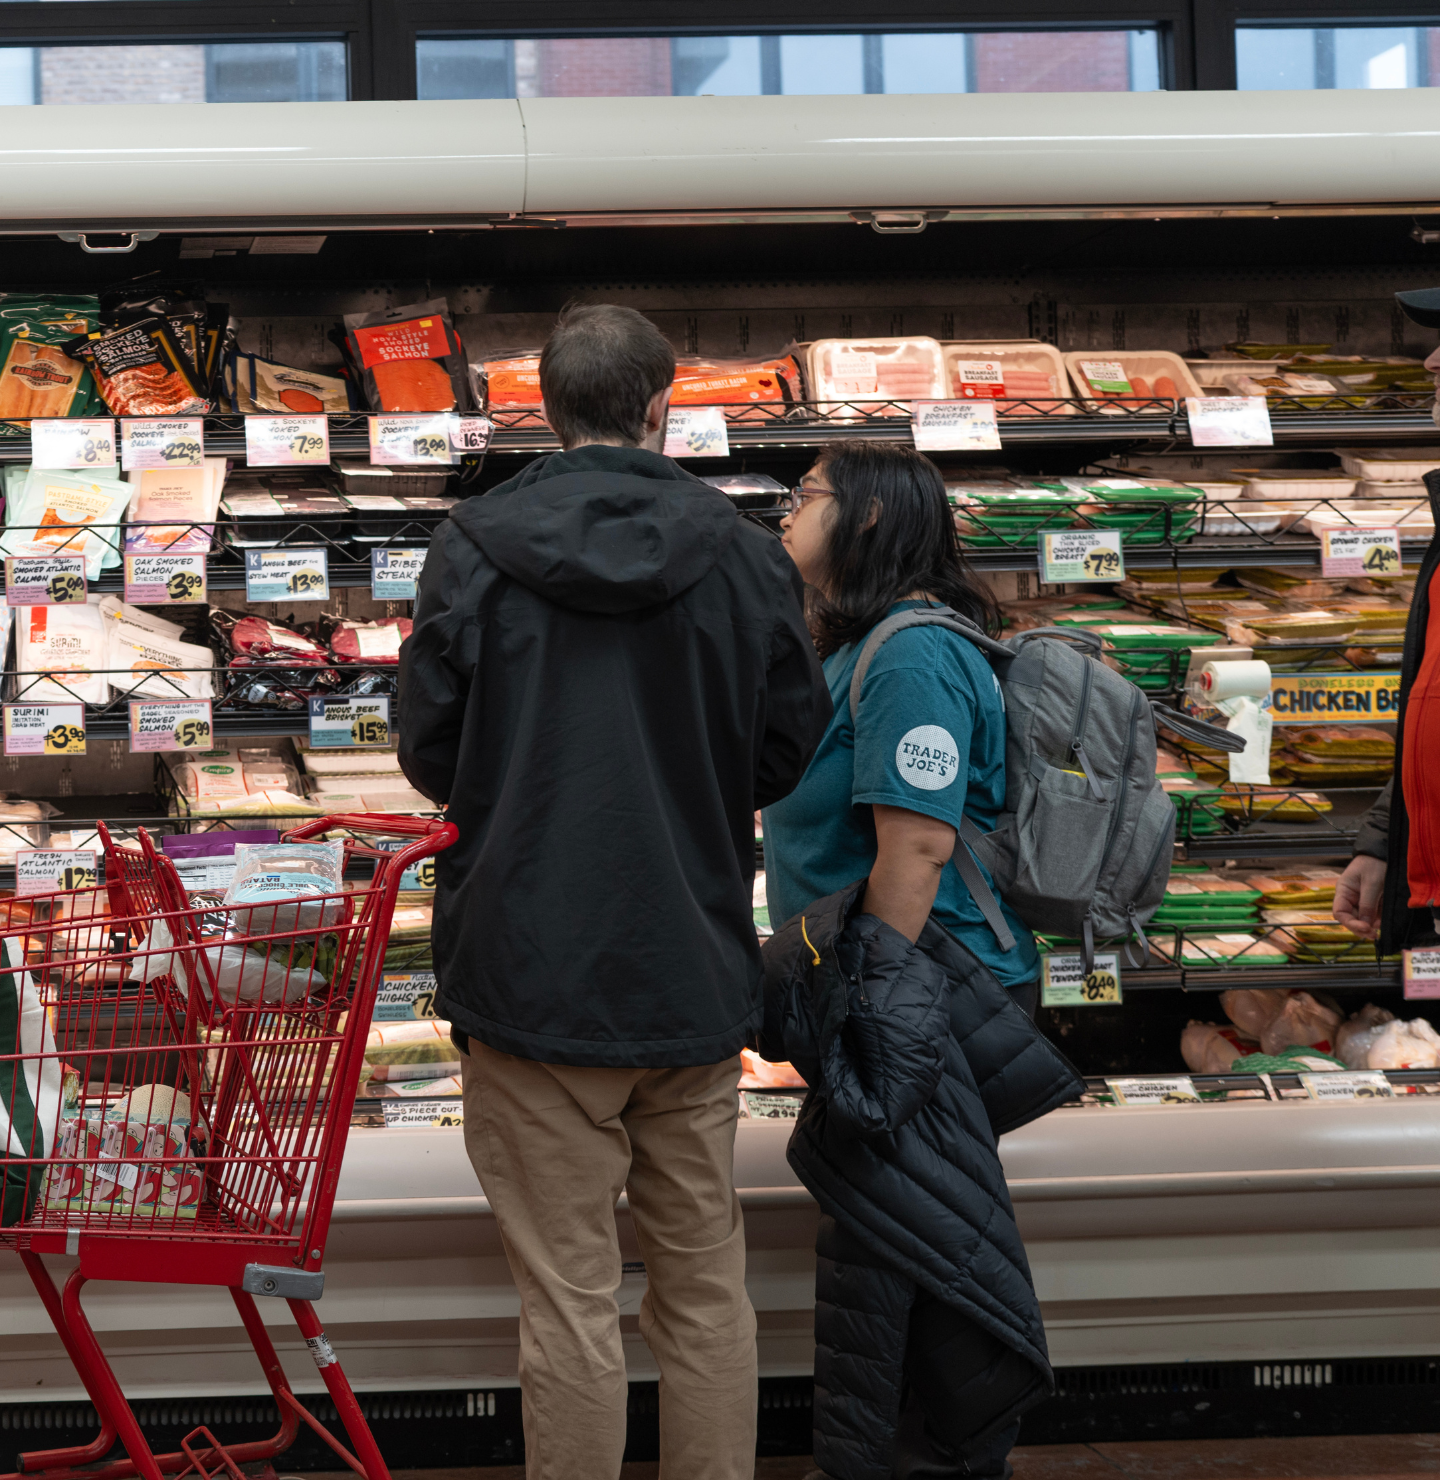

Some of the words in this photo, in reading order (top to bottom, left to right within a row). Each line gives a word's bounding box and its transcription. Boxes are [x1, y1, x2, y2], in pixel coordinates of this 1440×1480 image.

[401, 330, 430, 340] STYLE
[92, 329, 143, 351] SMOKED
[383, 337, 421, 347] SMOKED
[95, 336, 151, 358] SOCKEYE
[378, 342, 430, 355] SOCKEYE
[100, 343, 152, 362] SALMON
[383, 350, 430, 361] SALMON
[933, 405, 972, 413] CHICKEN
[381, 426, 420, 434] SOCKEYE
[134, 567, 173, 575] SALMON
[376, 571, 413, 579] STEAK
[1273, 688, 1372, 712] CHICKEN
[12, 708, 49, 716] SURIMI
[139, 716, 176, 724] SMOKED
[325, 713, 362, 721] BRISKET
[903, 742, 957, 768] TRADER
[203, 765, 233, 774] Empire
[906, 758, 948, 778] JOE'S
[17, 868, 56, 876] SALMON
[384, 982, 437, 991] CHICKEN
[376, 993, 413, 1002] THIGHS
[1138, 1084, 1178, 1092] CHICKEN
[1317, 1087, 1355, 1096] CHICKEN
[387, 1115, 399, 1123] UP
